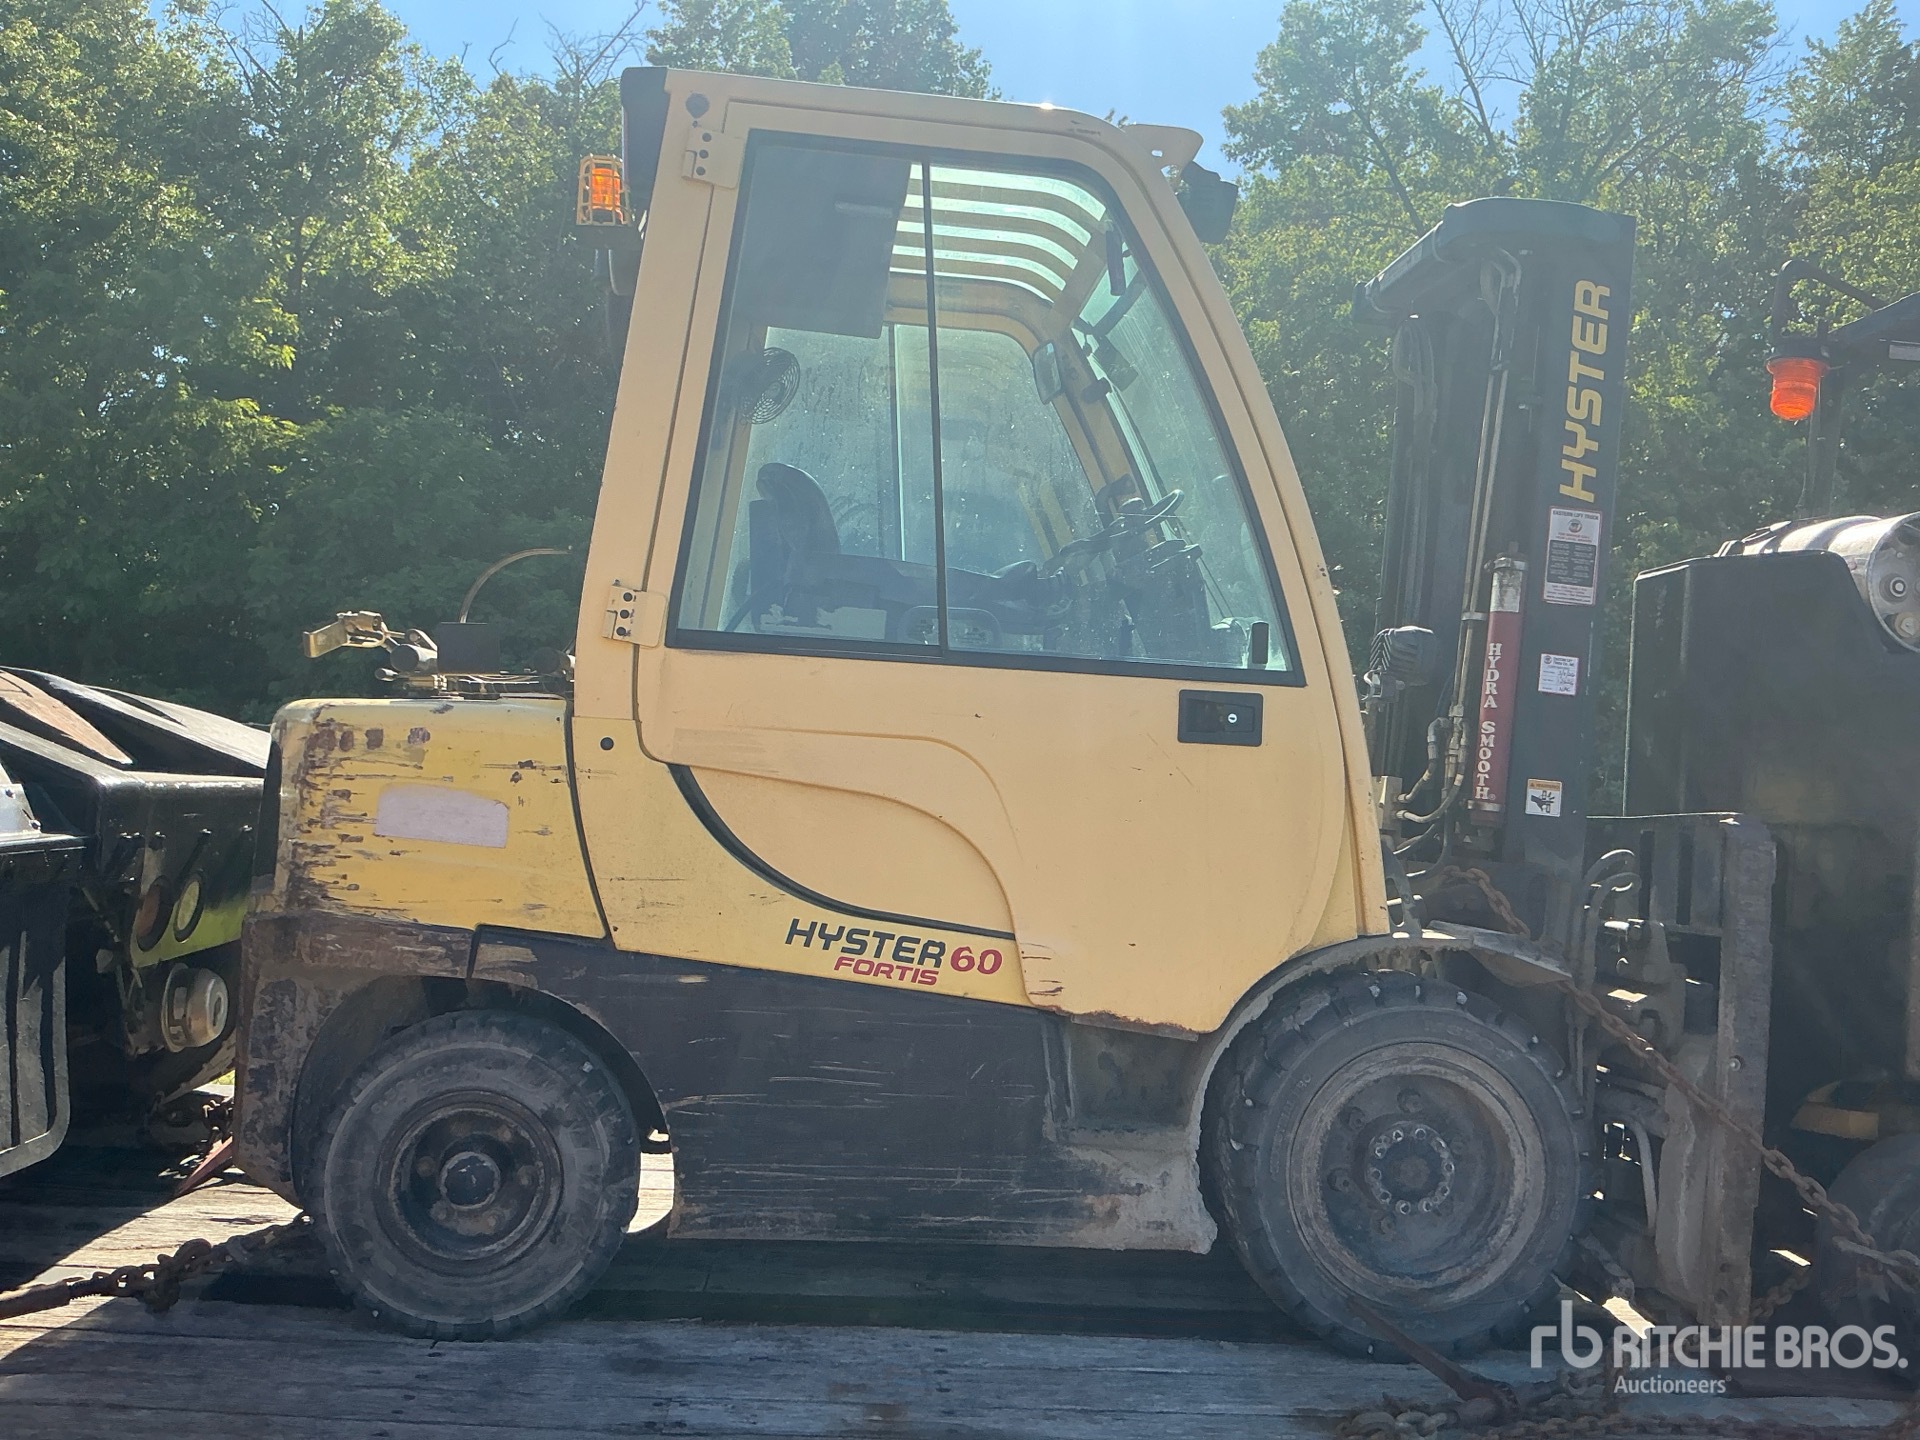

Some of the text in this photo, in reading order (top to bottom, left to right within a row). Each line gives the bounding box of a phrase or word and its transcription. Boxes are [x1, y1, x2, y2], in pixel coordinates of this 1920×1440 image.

[1559, 280, 1610, 503] HYSTER
[1483, 642, 1503, 709] HYDRA
[785, 918, 1003, 975] HYSTER 60
[833, 956, 939, 986] FORTIS
